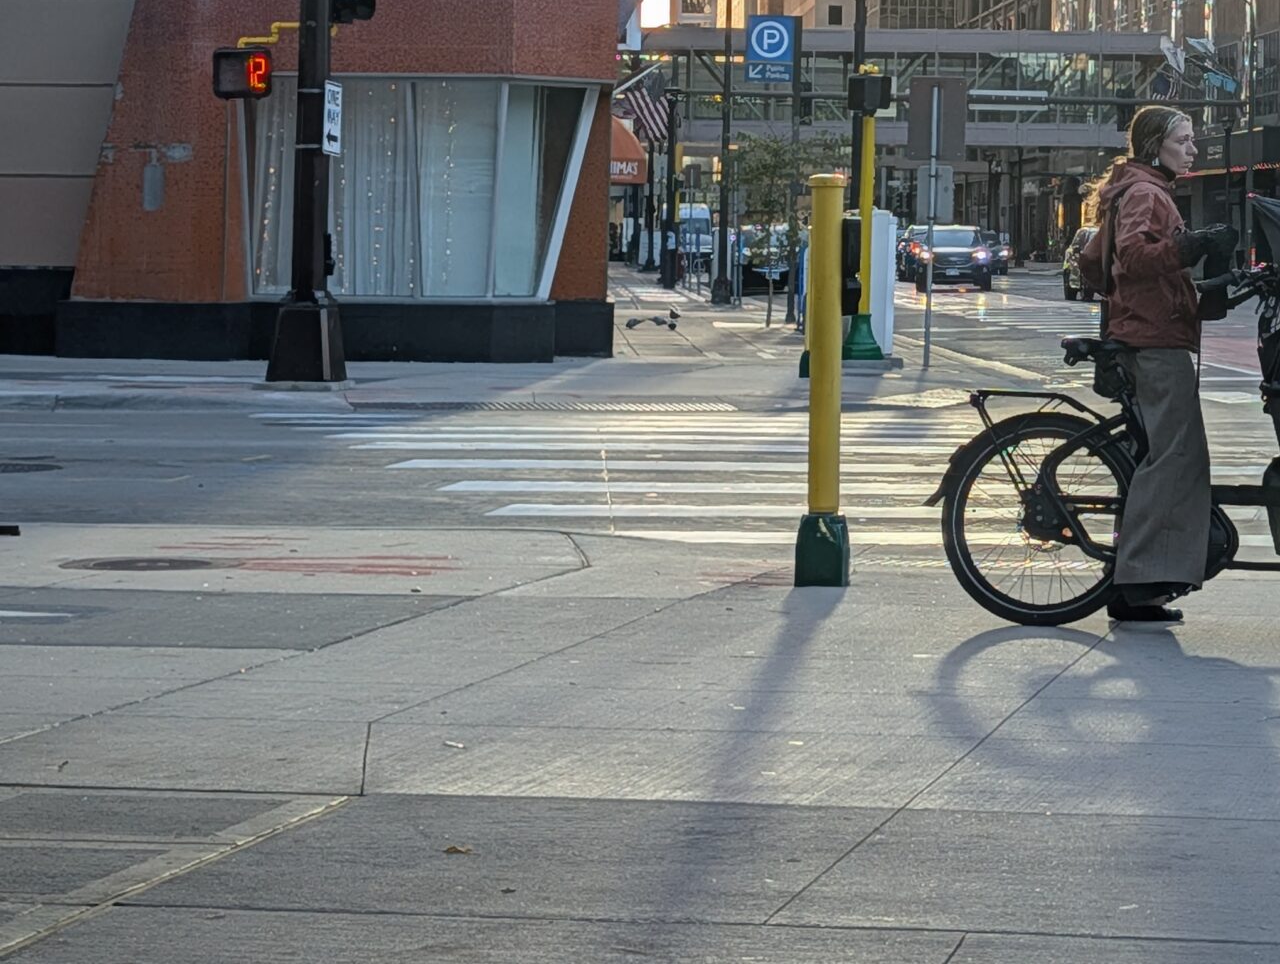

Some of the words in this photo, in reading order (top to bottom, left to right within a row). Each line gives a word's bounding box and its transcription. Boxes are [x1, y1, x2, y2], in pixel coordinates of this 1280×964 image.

[249, 56, 266, 88] 12
[327, 89, 340, 107] ONE
[327, 108, 340, 125] WAY
